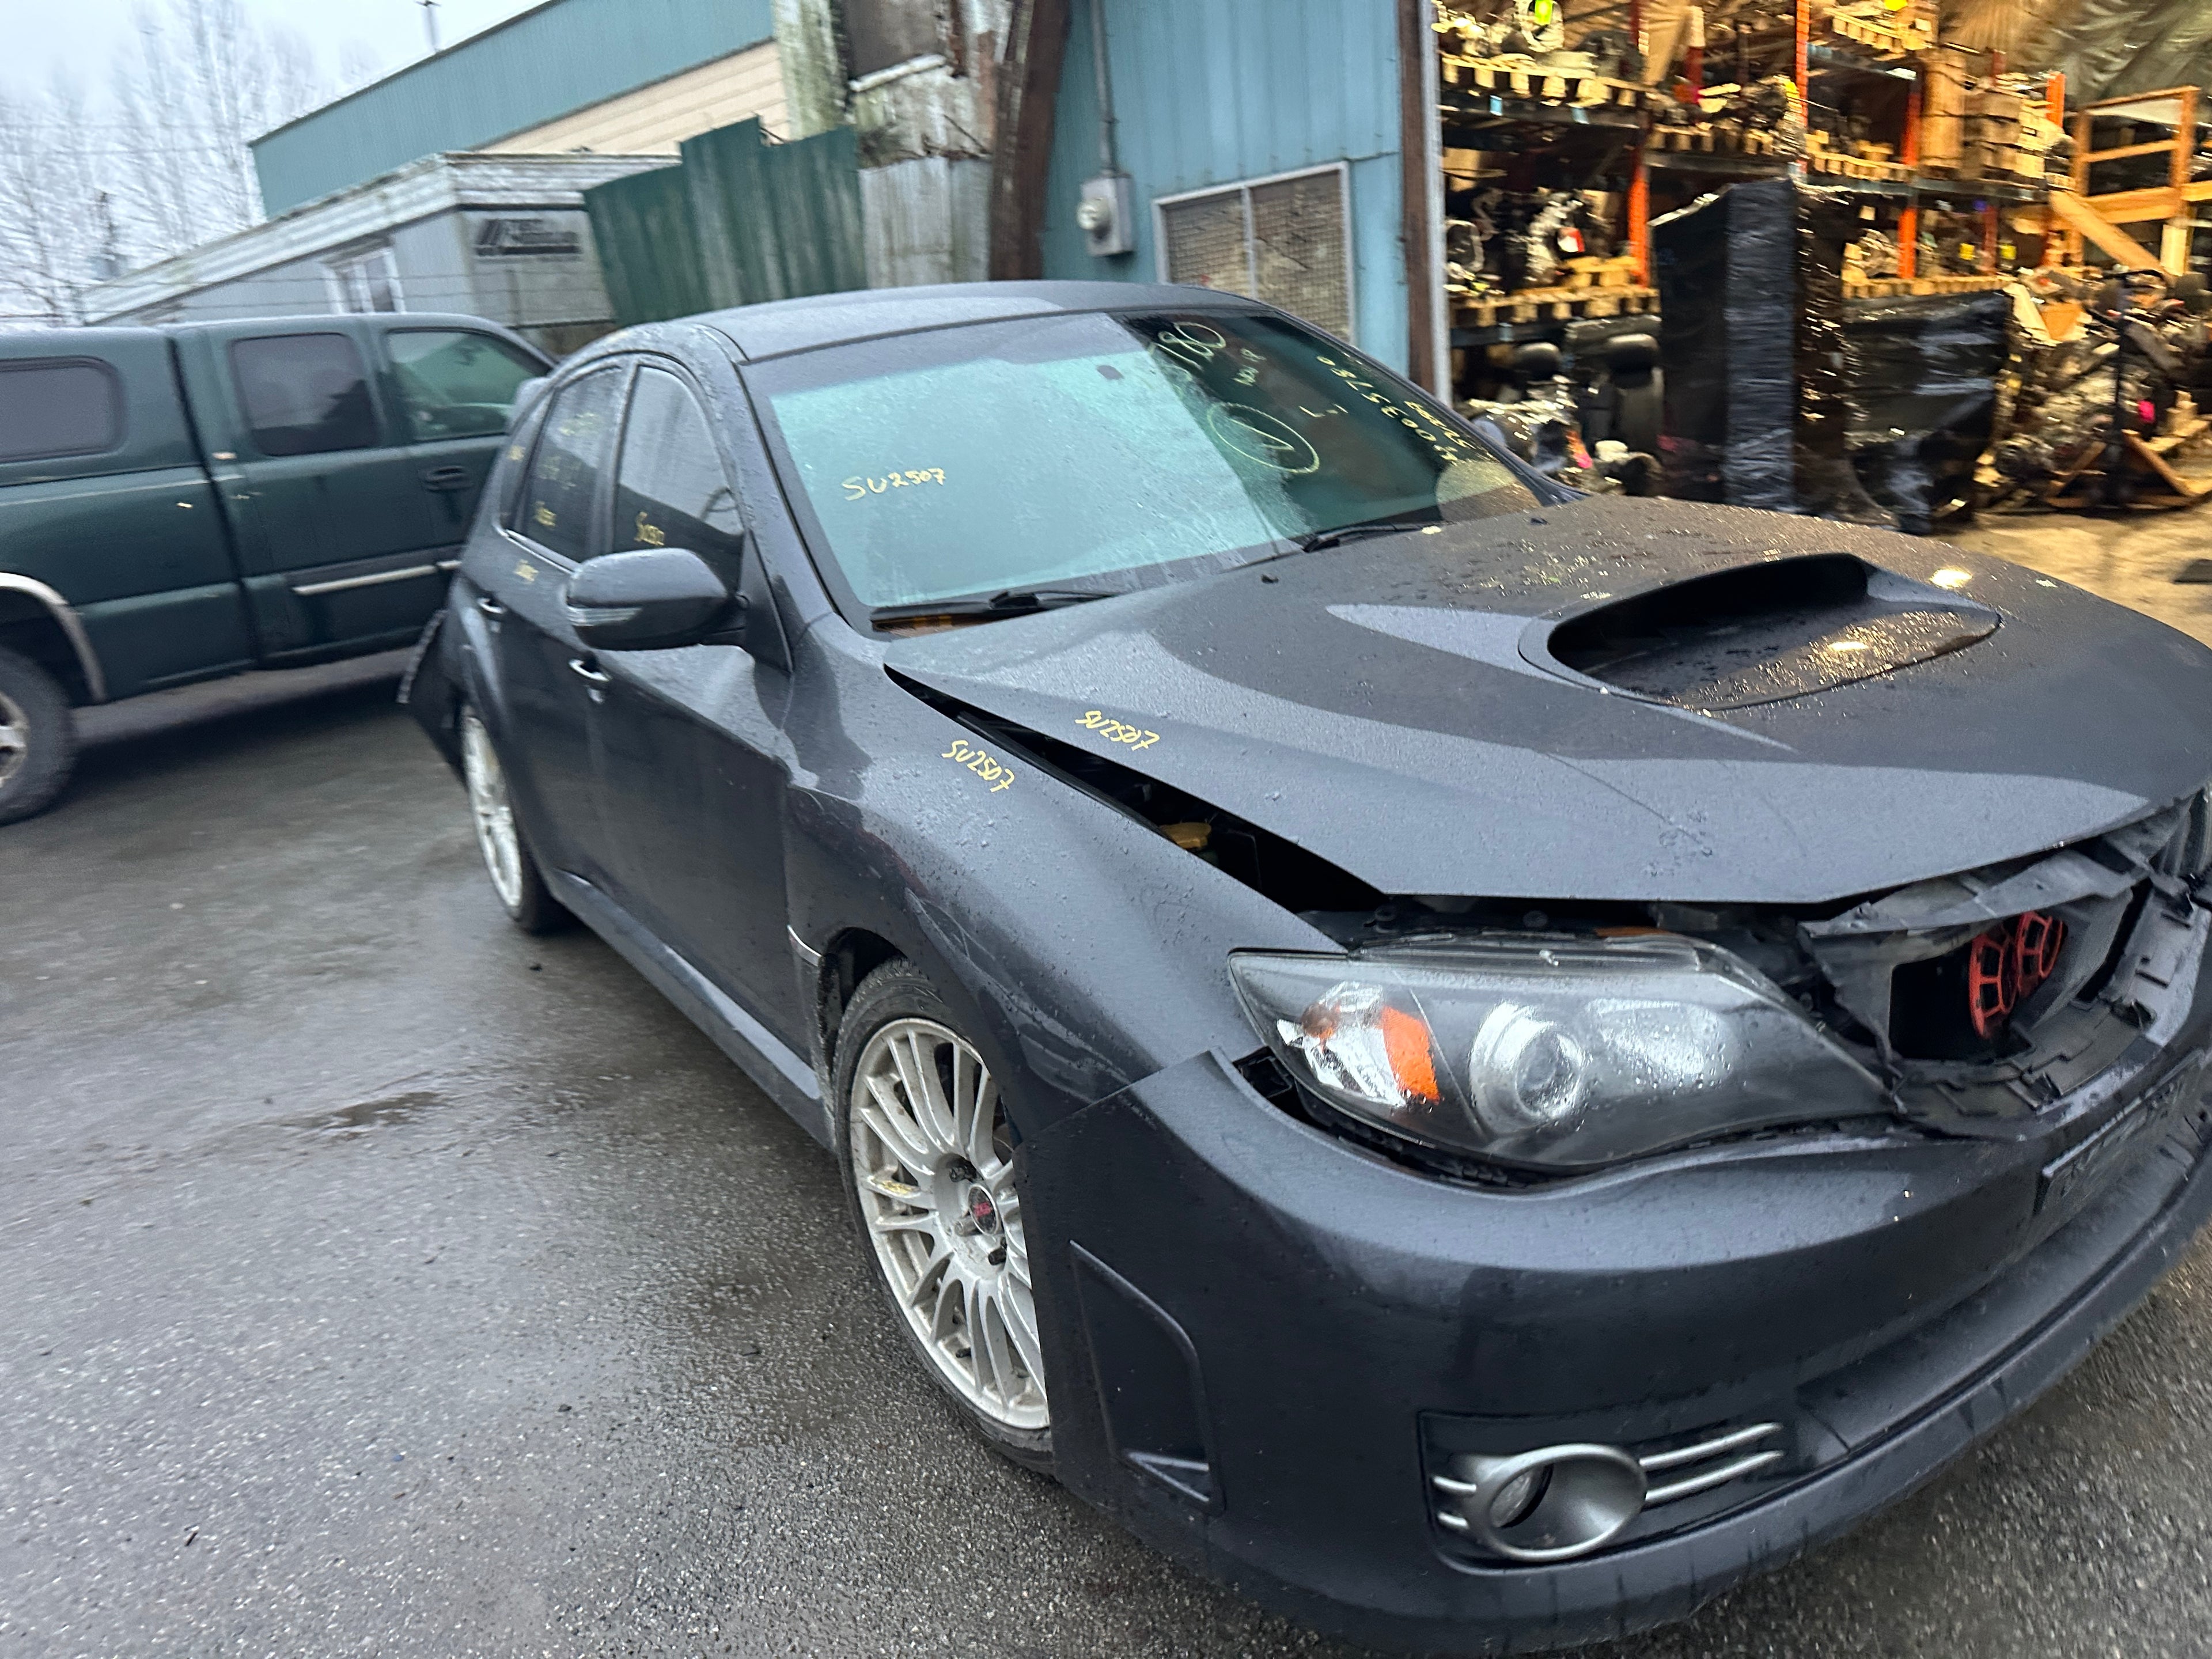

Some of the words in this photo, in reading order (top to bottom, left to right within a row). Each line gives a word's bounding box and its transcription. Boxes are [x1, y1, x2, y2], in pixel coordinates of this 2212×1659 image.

[842, 467, 946, 501] SU2507
[1074, 710, 1160, 751] SU2507
[941, 740, 1015, 793] SU2507
